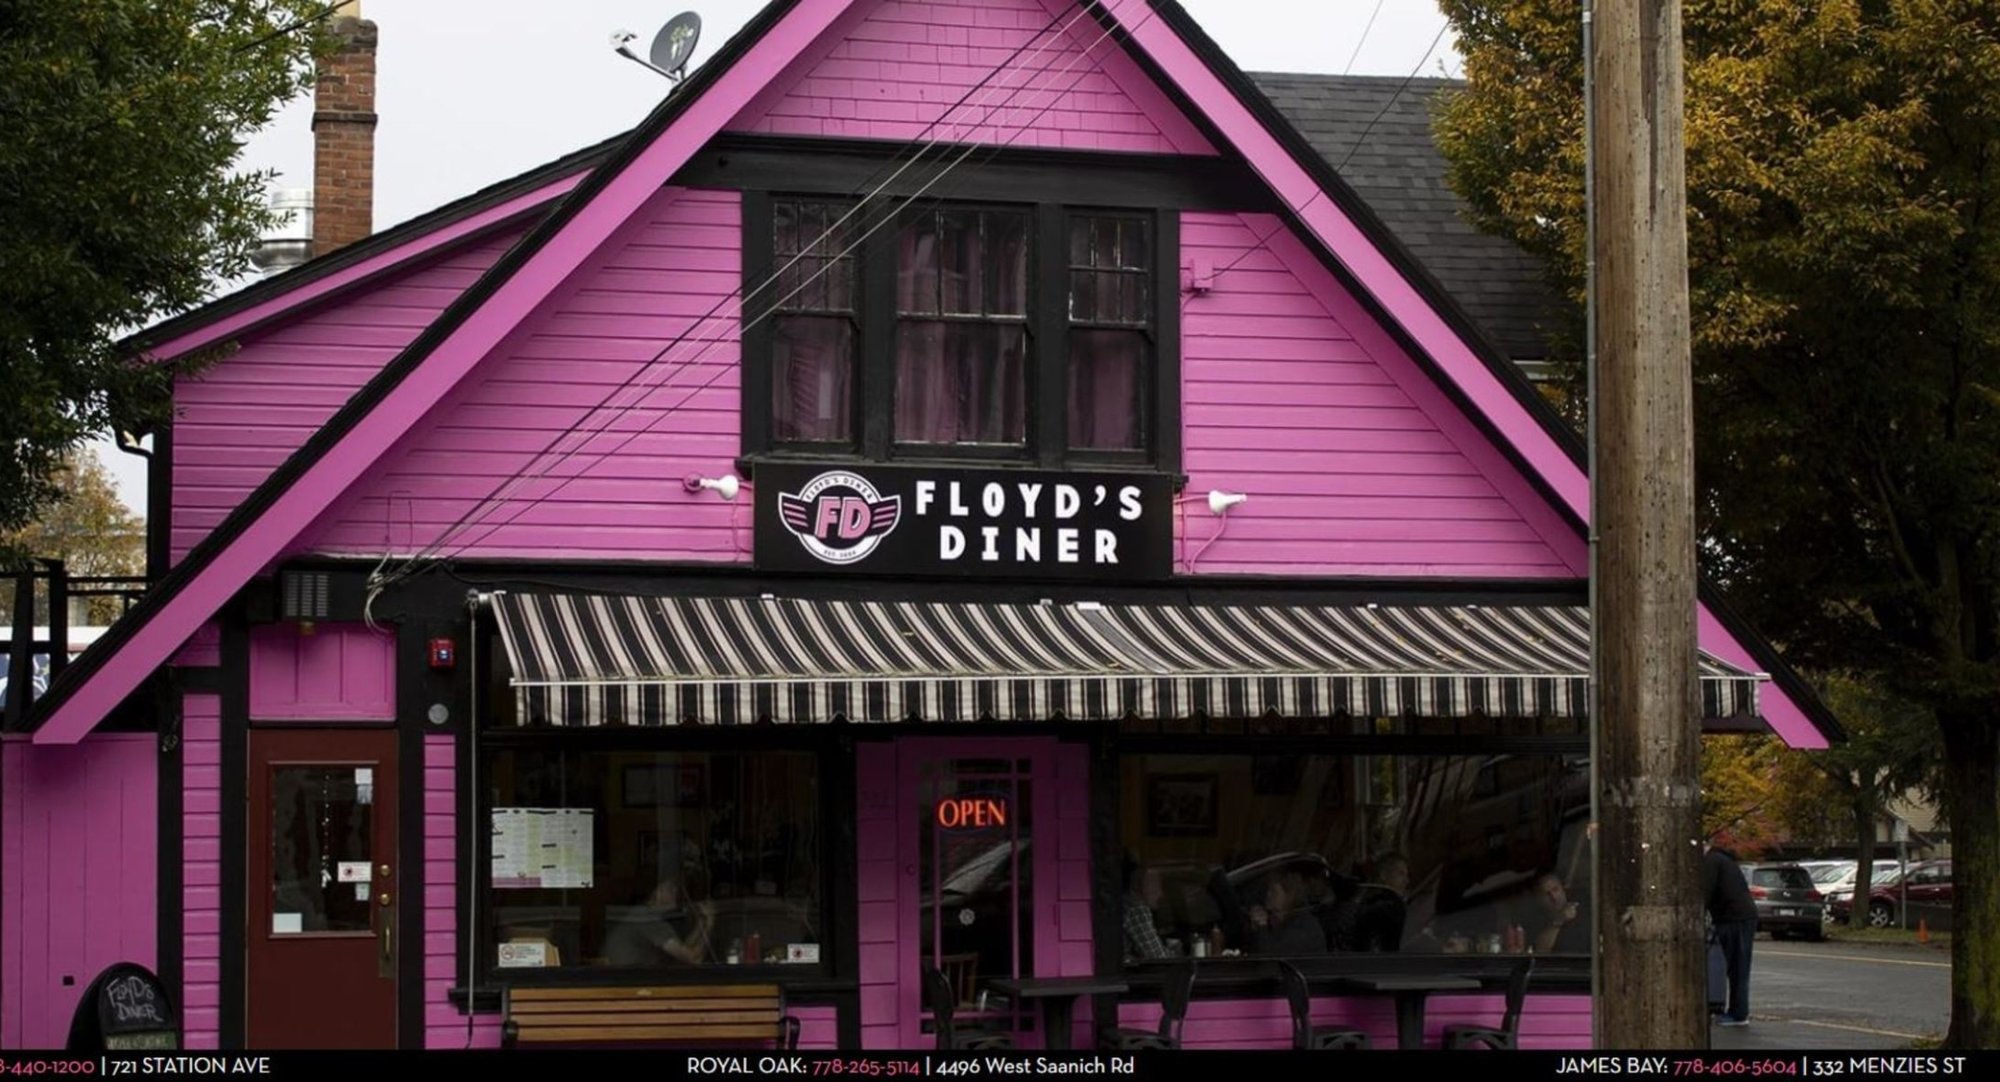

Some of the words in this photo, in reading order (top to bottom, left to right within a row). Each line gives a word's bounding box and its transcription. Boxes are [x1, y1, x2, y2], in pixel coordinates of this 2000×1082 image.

[815, 496, 871, 538] FD
[940, 525, 1119, 563] DINER
[938, 798, 1007, 828] OPEN
